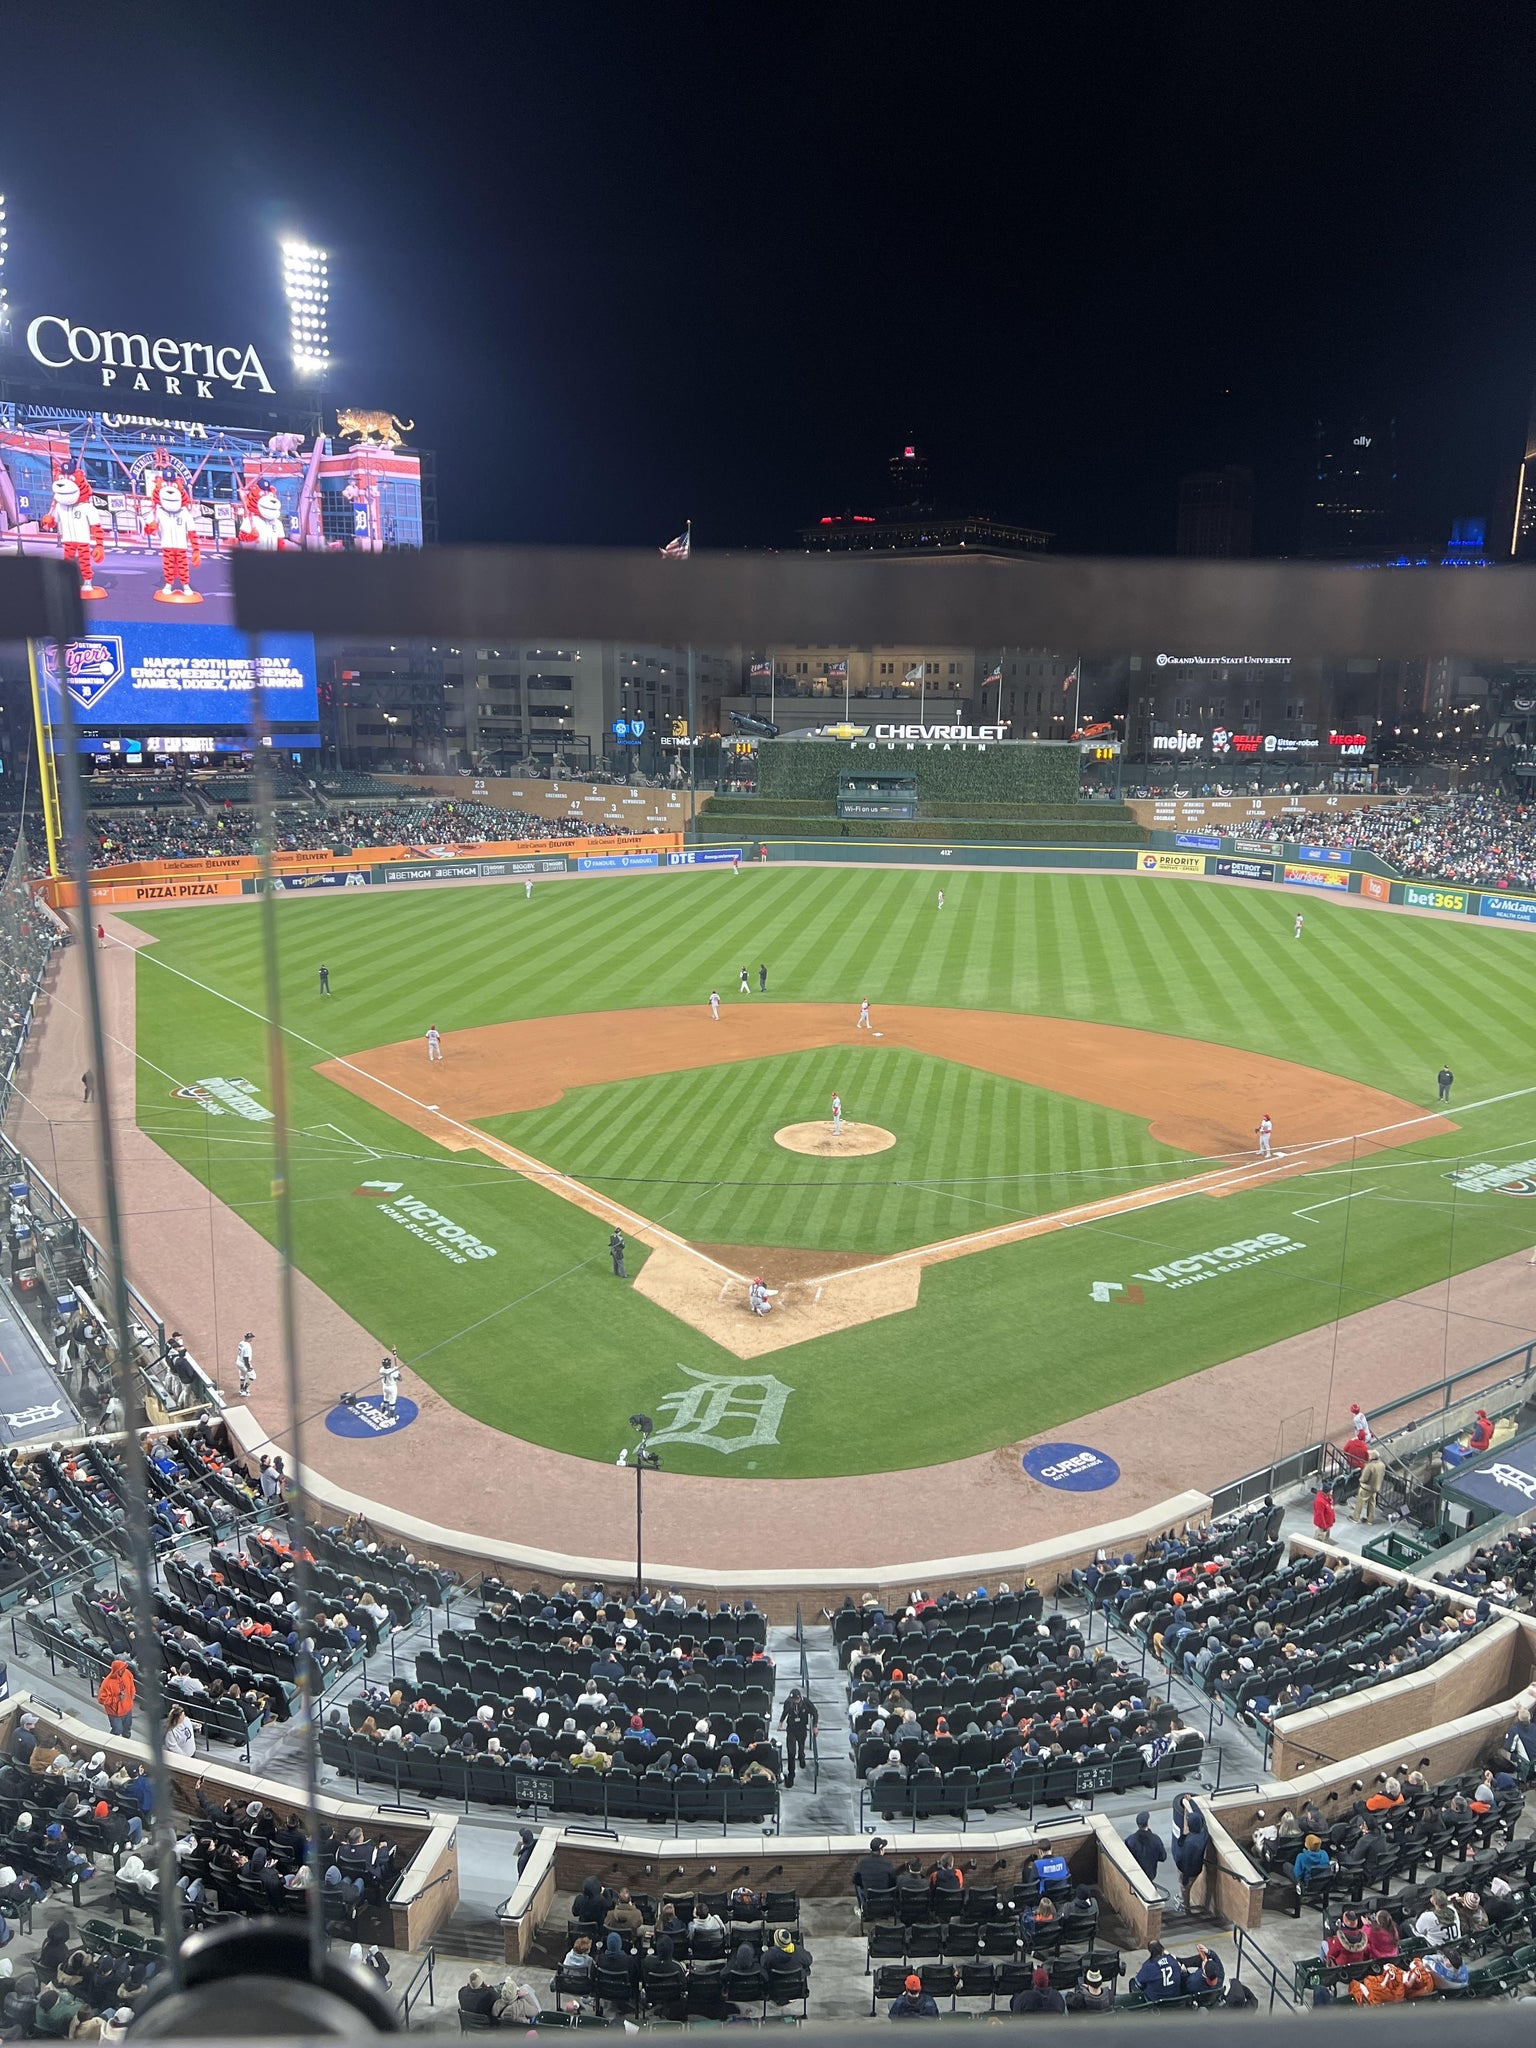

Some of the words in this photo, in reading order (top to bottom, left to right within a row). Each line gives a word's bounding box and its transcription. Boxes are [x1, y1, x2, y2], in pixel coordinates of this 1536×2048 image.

[101, 367, 214, 398] PARK
[141, 432, 175, 443] PARK
[1353, 436, 1371, 447] ally
[143, 657, 190, 669] HAPPY
[191, 658, 227, 669] 30TH
[227, 657, 290, 669] BIRTHDAY
[1167, 656, 1194, 664] GRAND
[1194, 656, 1220, 664] VALLEY
[1221, 656, 1244, 664] STATE
[1244, 656, 1291, 664] UNIVERSITY
[221, 669, 256, 679] LOVE
[228, 679, 256, 690] AND
[875, 724, 1007, 740] CHEVROLET
[1153, 733, 1203, 753] meijer
[1233, 736, 1263, 744] BELLE
[1330, 735, 1366, 745] FIEGER
[850, 742, 986, 751] FOUNTAIN
[1236, 744, 1258, 752] TIRE
[1341, 745, 1366, 755] LAW
[592, 786, 597, 794] 2
[630, 789, 638, 798] 16
[671, 793, 676, 801] 6
[1290, 798, 1299, 806] 11
[1326, 797, 1338, 806] 42
[570, 801, 580, 809] 47
[611, 804, 617, 812] 3
[1252, 799, 1262, 809] 10
[630, 857, 653, 865] FANDUEL
[671, 853, 695, 864] DTE
[1160, 856, 1199, 866] PRIORITY
[180, 861, 203, 869] Caesars
[1232, 862, 1261, 871] DETROIT
[396, 869, 431, 879] BETMGM
[441, 867, 476, 877] BETMGM
[1287, 868, 1324, 883] Surfside
[137, 886, 176, 899] PIZZA!
[180, 884, 218, 896] PIZZA!
[1408, 889, 1463, 910] bet365
[393, 1195, 497, 1259] VICTORS
[376, 1204, 410, 1224] HOME
[405, 1223, 467, 1264] SOLUTIONS
[1131, 1233, 1291, 1283] VICTORS
[1165, 1270, 1218, 1289] HOME
[1217, 1242, 1307, 1273] SOLUTIONS
[1041, 1456, 1086, 1477] CURE
[1053, 1472, 1070, 1481] AUTO
[1092, 1769, 1097, 1778] 2
[532, 1780, 537, 1788] 3
[1082, 1781, 1093, 1789] 3-5
[521, 1790, 534, 1798] 4-5
[537, 1792, 548, 1800] 1-2
[1161, 1967, 1174, 1987] 12
